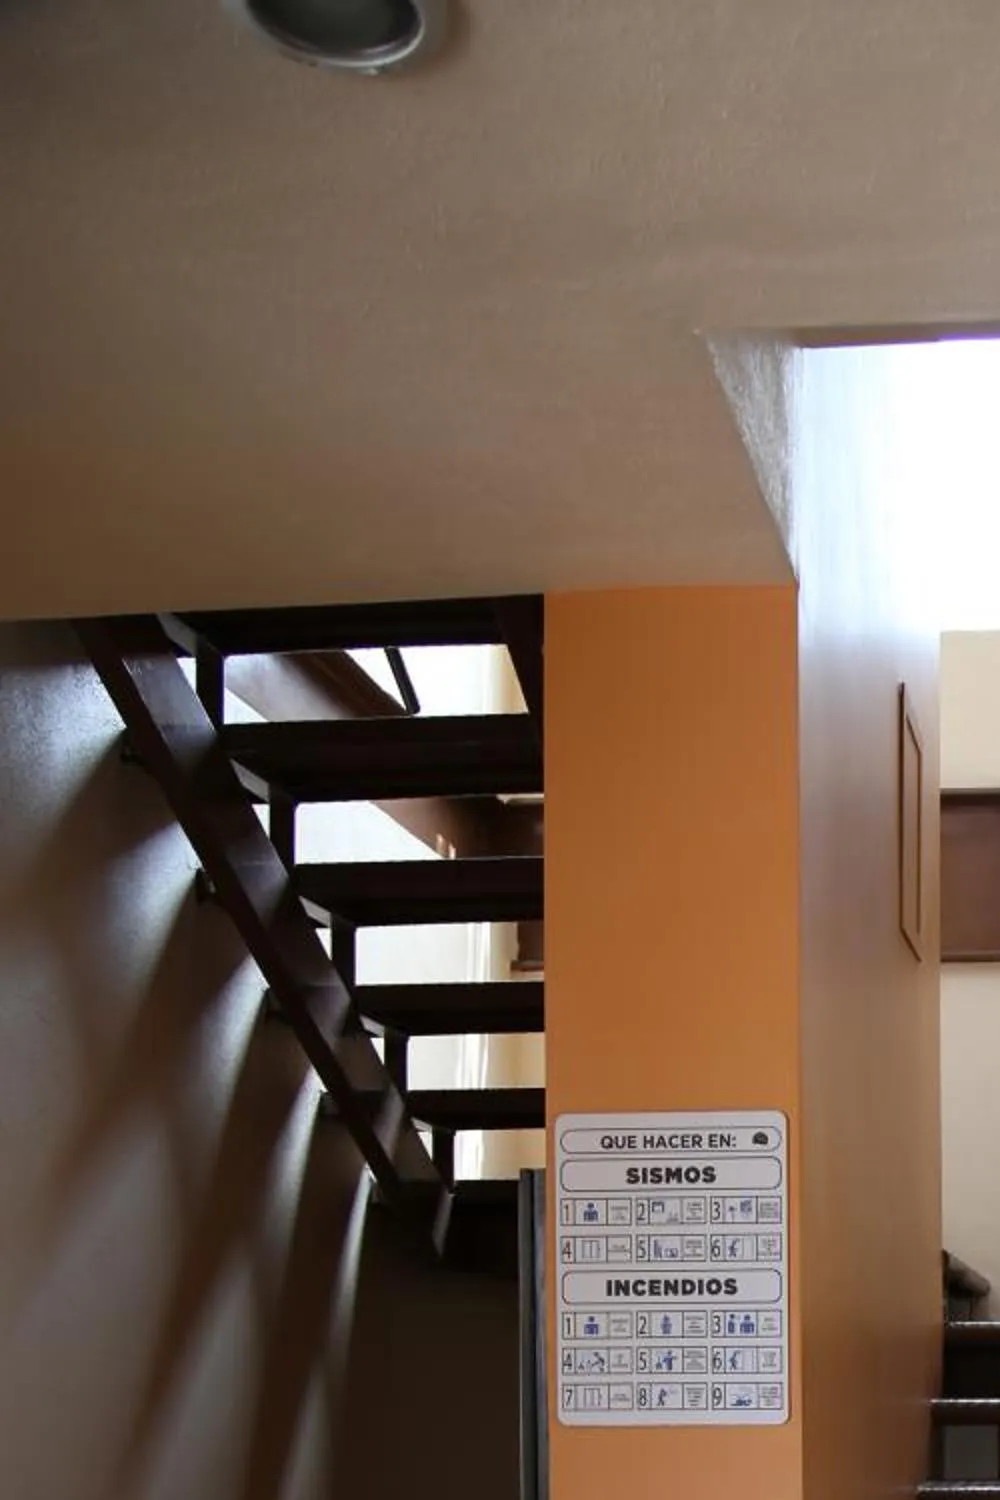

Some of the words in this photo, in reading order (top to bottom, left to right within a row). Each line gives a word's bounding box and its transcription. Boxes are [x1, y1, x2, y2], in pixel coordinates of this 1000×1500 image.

[600, 1134, 637, 1150] QUE
[643, 1133, 703, 1149] HACER
[708, 1132, 737, 1148] EN:
[625, 1165, 717, 1185] SISMOS
[563, 1201, 572, 1220] 1
[637, 1200, 645, 1220] 2
[712, 1201, 721, 1220] 3
[562, 1238, 572, 1259] 4
[637, 1239, 645, 1259] 5
[711, 1238, 721, 1258] 6
[605, 1278, 738, 1297] INCENDIOS
[565, 1316, 572, 1336] 1
[638, 1315, 647, 1335] 2
[712, 1315, 721, 1334] 3
[563, 1351, 572, 1371] 4
[639, 1351, 647, 1371] 5
[712, 1351, 721, 1370] 6
[565, 1389, 573, 1407] 7
[638, 1388, 647, 1406] 8
[712, 1387, 721, 1405] 9
